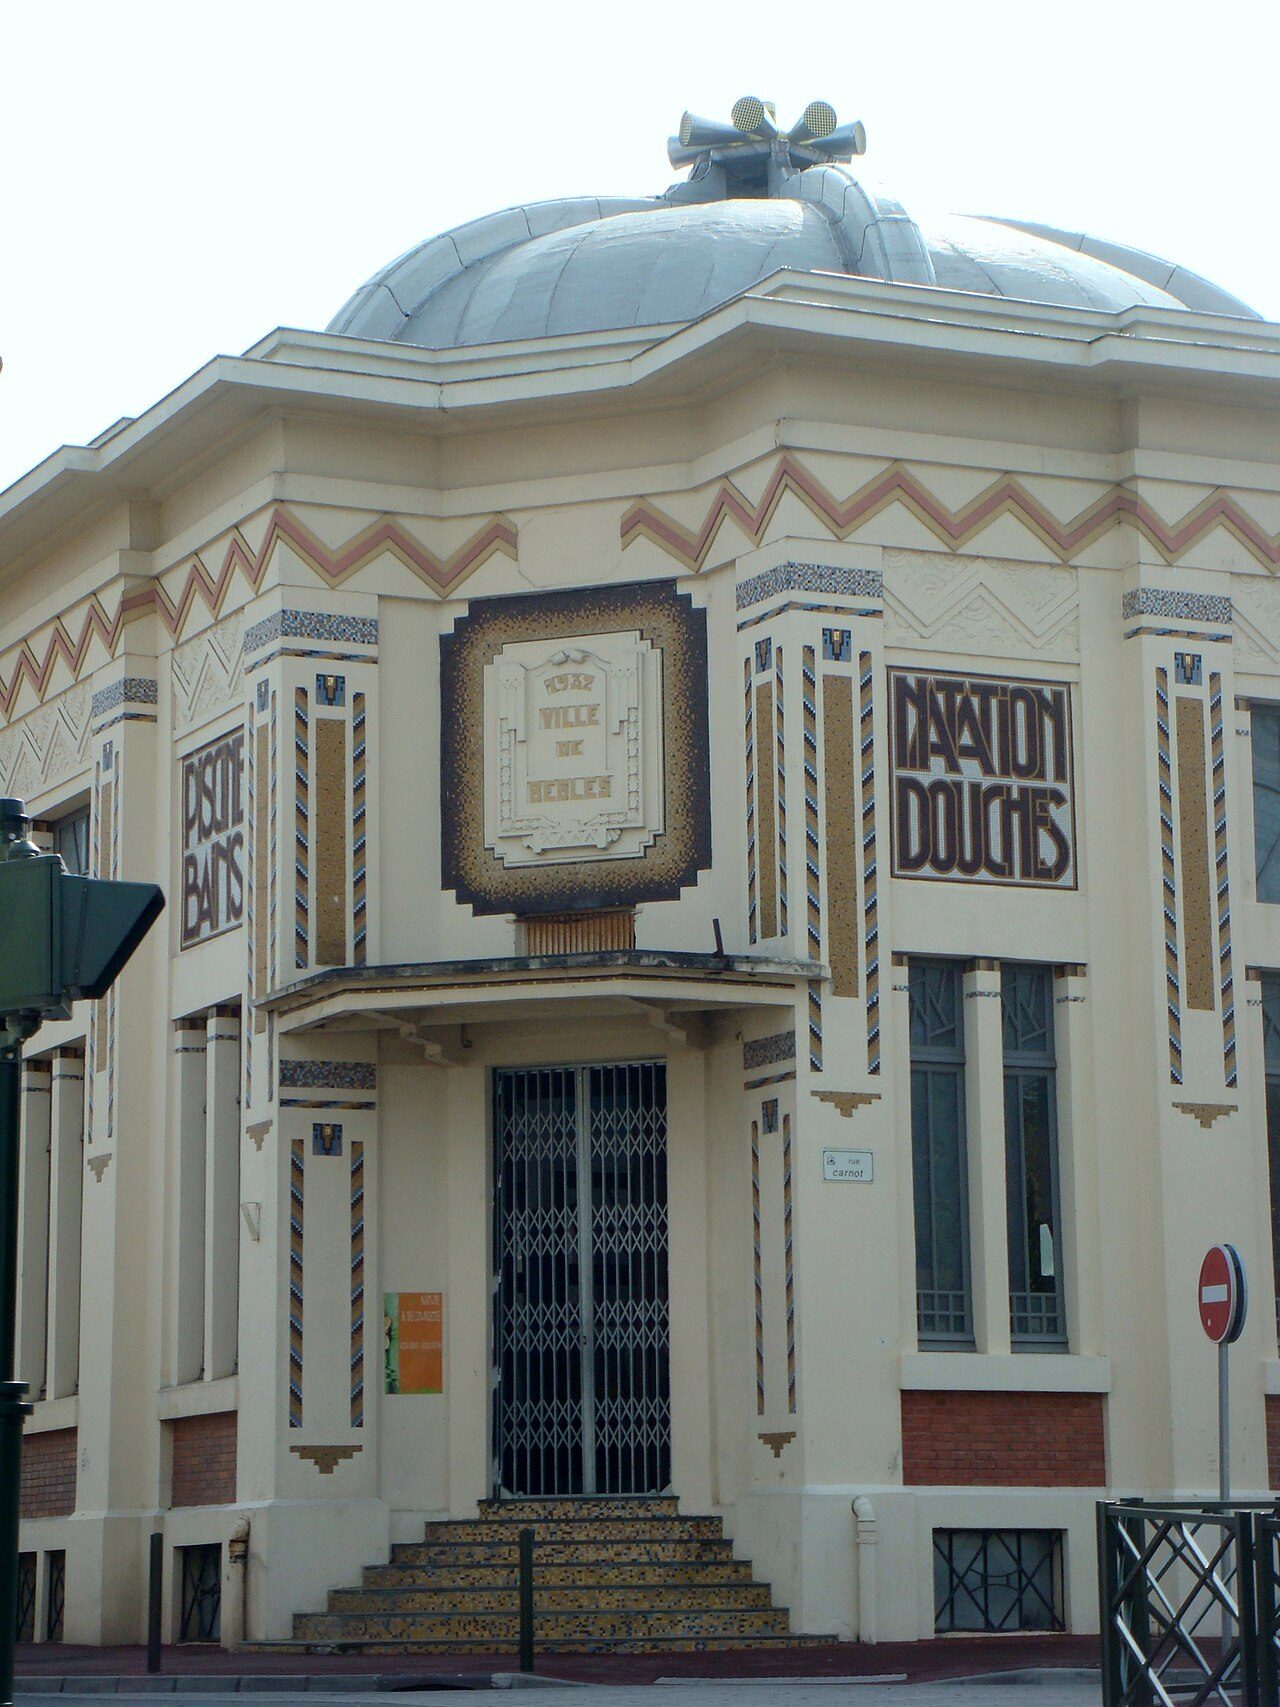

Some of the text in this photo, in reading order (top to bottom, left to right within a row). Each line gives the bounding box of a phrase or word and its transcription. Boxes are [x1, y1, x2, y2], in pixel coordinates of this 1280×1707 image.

[539, 703, 600, 730] VILLE
[544, 672, 594, 694] 1932
[556, 739, 584, 757] DE
[894, 674, 1067, 783] NATATION
[184, 733, 244, 851] PISCINE
[896, 775, 1070, 882] DOUCHES
[183, 830, 243, 941] BAINS
[832, 1169, 863, 1177] carnot
